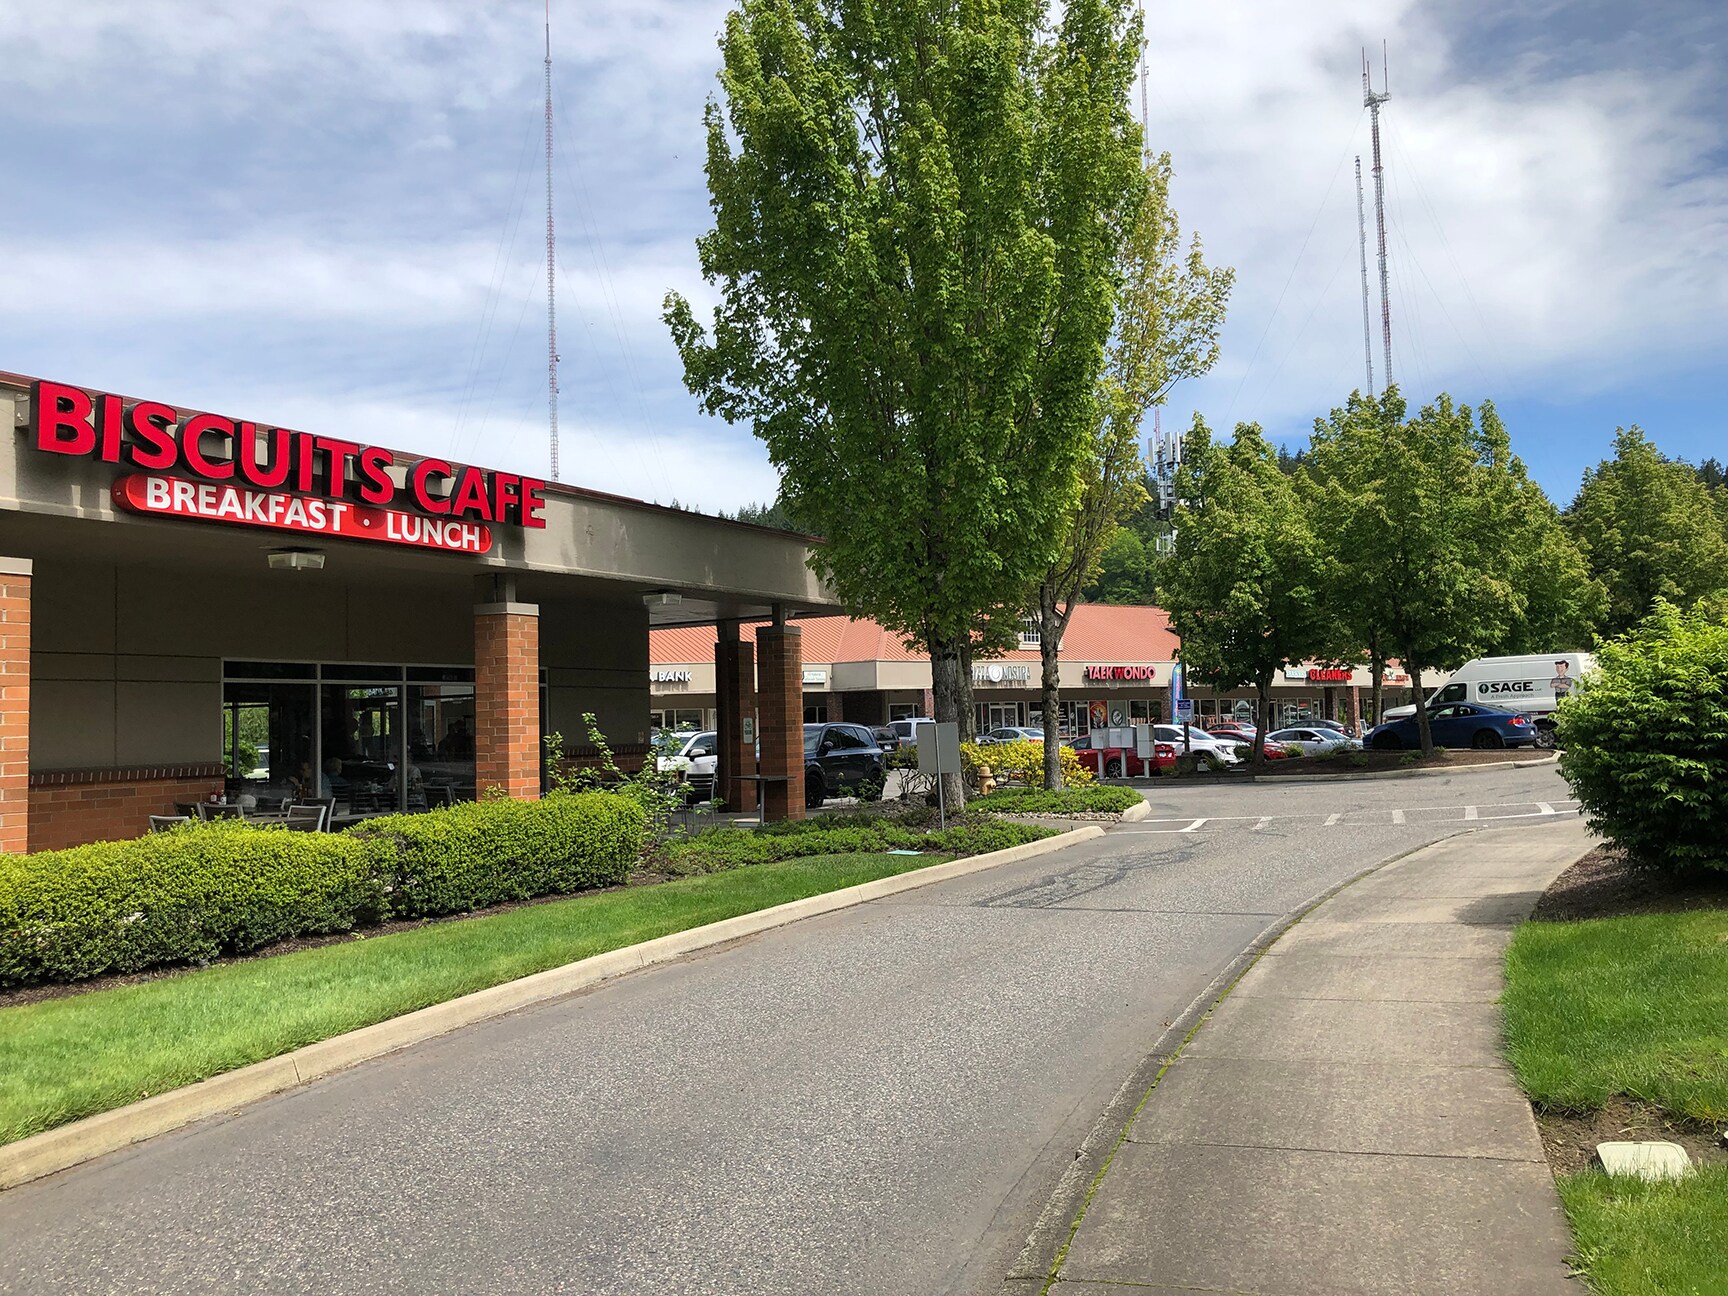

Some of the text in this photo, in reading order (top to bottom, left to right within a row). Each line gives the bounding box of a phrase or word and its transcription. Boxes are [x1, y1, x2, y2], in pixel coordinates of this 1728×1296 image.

[31, 381, 547, 529] BISCUITS CAFE
[146, 477, 480, 551] BREAKFAST LUNCH
[659, 671, 693, 682] BANK
[972, 666, 1031, 680] IZZA NOSTRA
[1087, 665, 1157, 680] TAEKWONDO
[1310, 668, 1352, 680] CLEANERS
[1491, 682, 1533, 693] SAGE
